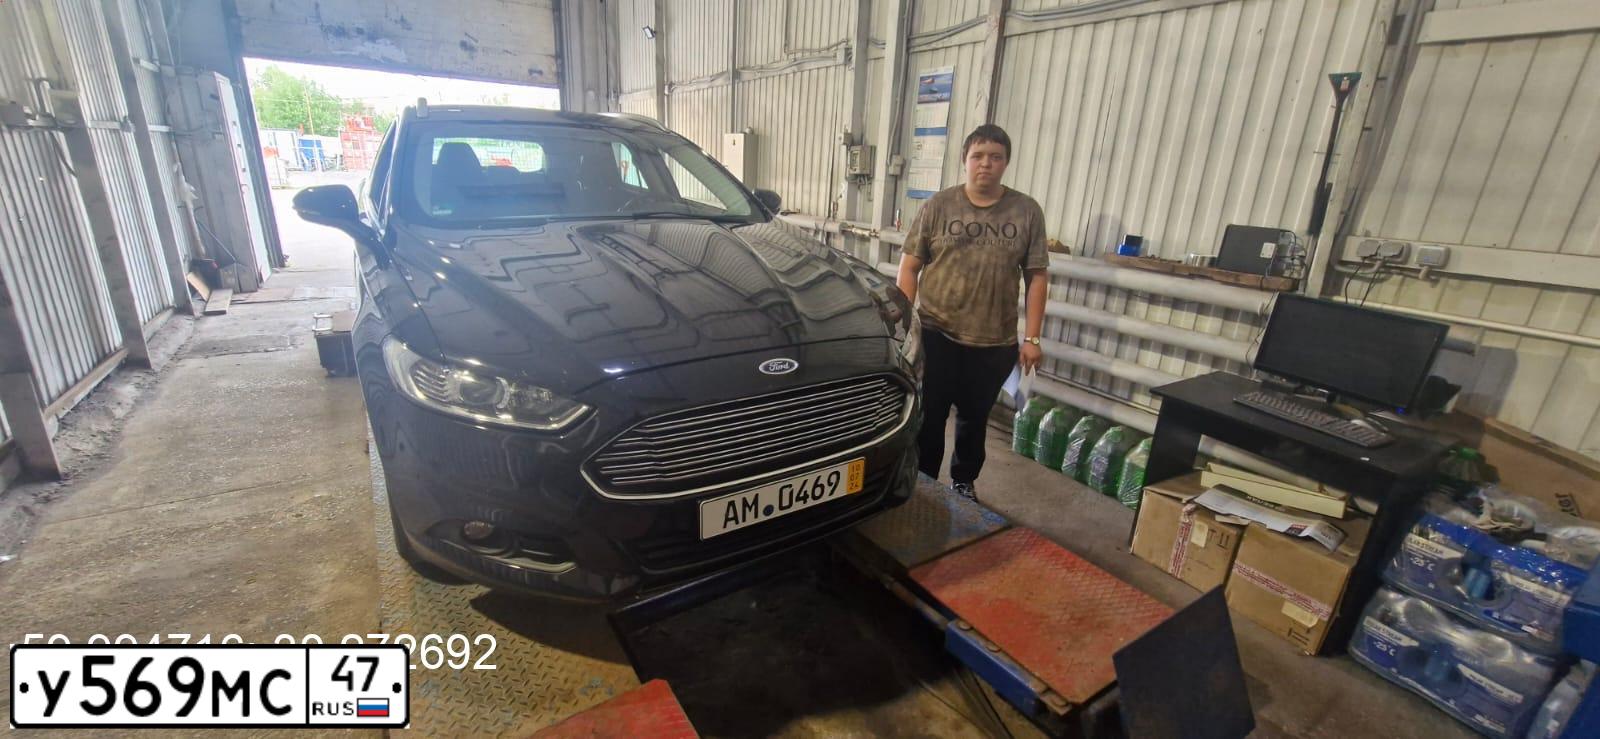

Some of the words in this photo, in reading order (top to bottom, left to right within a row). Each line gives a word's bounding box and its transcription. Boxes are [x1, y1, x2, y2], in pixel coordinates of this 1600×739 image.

[942, 219, 1018, 240] ICONO
[722, 493, 760, 529] AM
[778, 470, 841, 511] 0469
